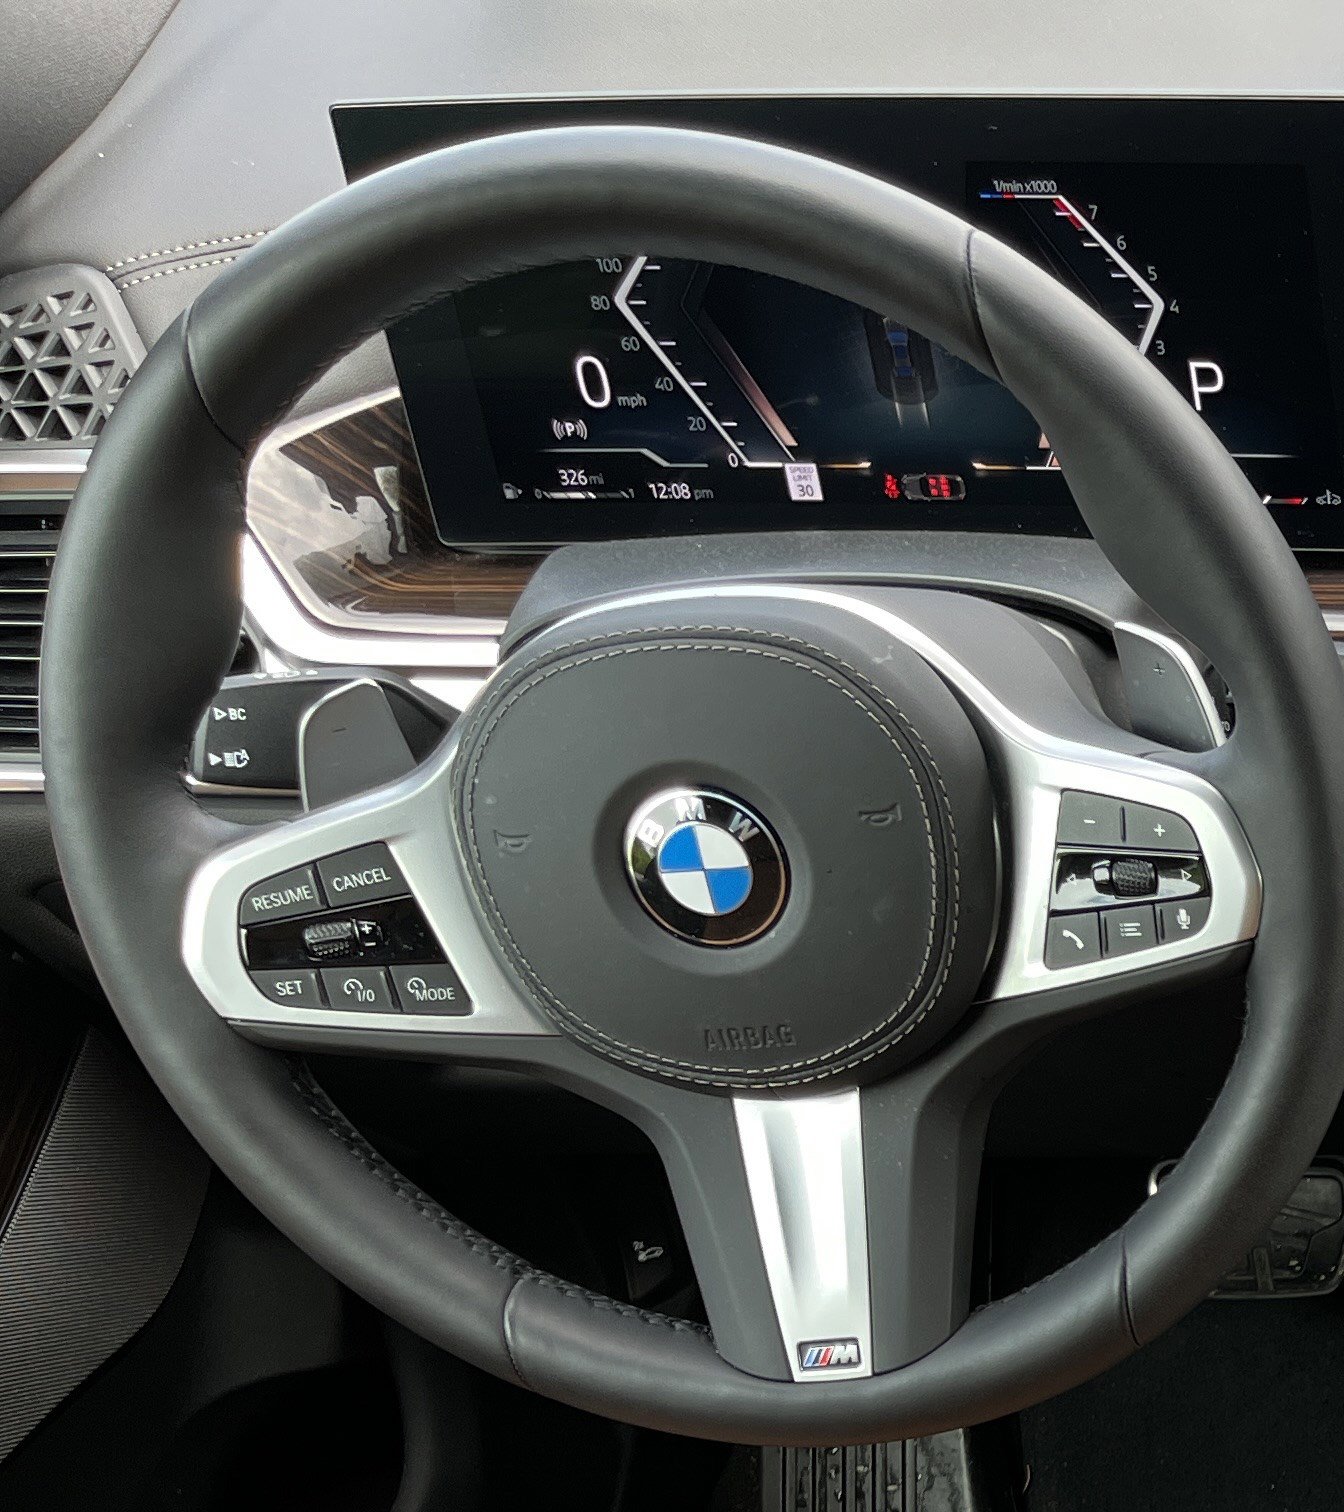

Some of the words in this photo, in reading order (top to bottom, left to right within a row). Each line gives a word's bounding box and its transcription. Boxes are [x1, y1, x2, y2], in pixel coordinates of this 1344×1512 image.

[1088, 205, 1098, 220] 7
[1116, 235, 1126, 250] 6
[596, 258, 622, 274] 100
[1147, 266, 1158, 282] 5
[590, 296, 610, 310] 80
[1169, 300, 1180, 314] 4
[621, 336, 640, 351] 60
[1155, 340, 1166, 356] 3
[575, 354, 612, 408] 0
[655, 376, 674, 392] 40
[1188, 360, 1224, 411] P
[617, 394, 647, 408] mph
[687, 416, 706, 432] 20
[727, 453, 738, 468] 0
[558, 469, 588, 486] 326
[788, 466, 814, 474] SPEED
[648, 482, 691, 500] 12:08
[694, 490, 714, 501] pm
[796, 484, 814, 498] 30
[228, 708, 246, 720] BC
[638, 796, 760, 848] BMW
[332, 868, 391, 892] CANCEL
[252, 886, 313, 912] RESUME
[276, 980, 302, 996] SET
[415, 988, 455, 1002] MODE
[704, 1024, 797, 1051] AIRBAG
